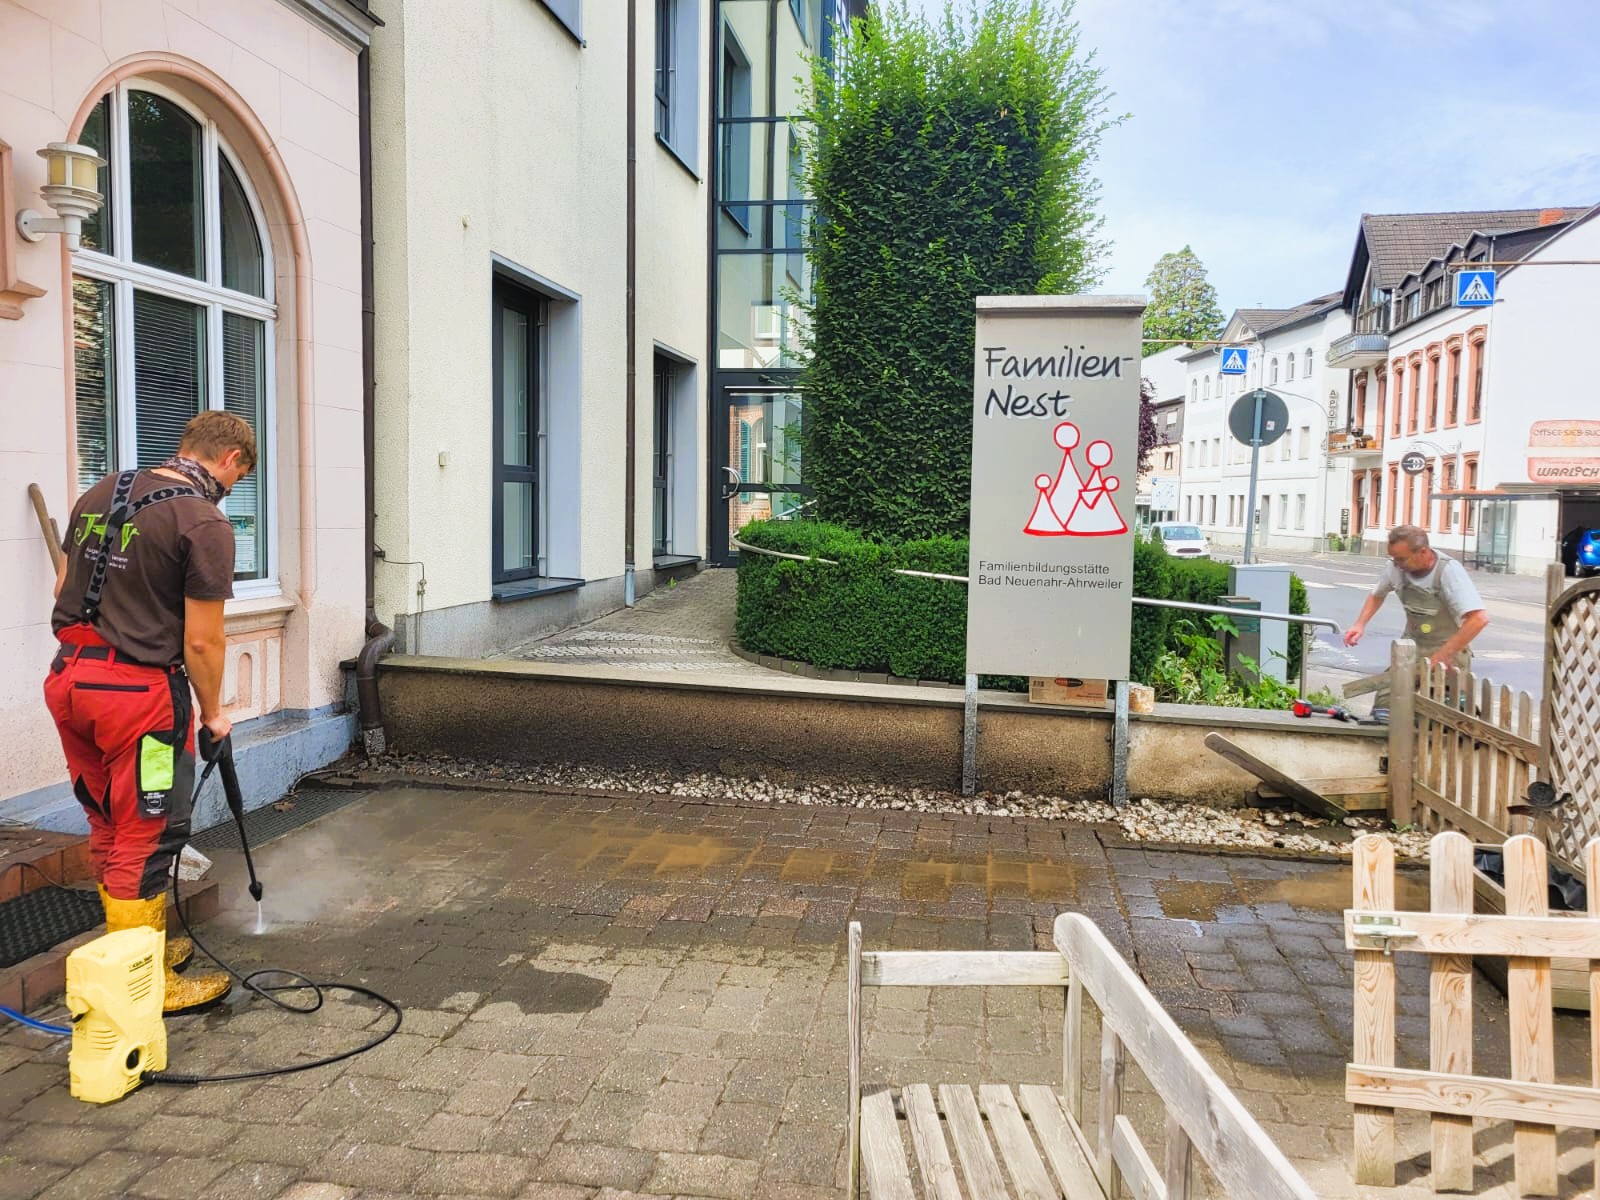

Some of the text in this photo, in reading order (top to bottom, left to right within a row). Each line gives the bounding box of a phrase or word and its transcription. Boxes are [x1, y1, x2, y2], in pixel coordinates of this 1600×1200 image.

[983, 345, 1134, 378] Familien-
[984, 384, 1071, 417] Nest
[979, 560, 1110, 576] Familienbildungsstätte
[978, 574, 1123, 589] Bad Neuenahr-Ahrweiler
